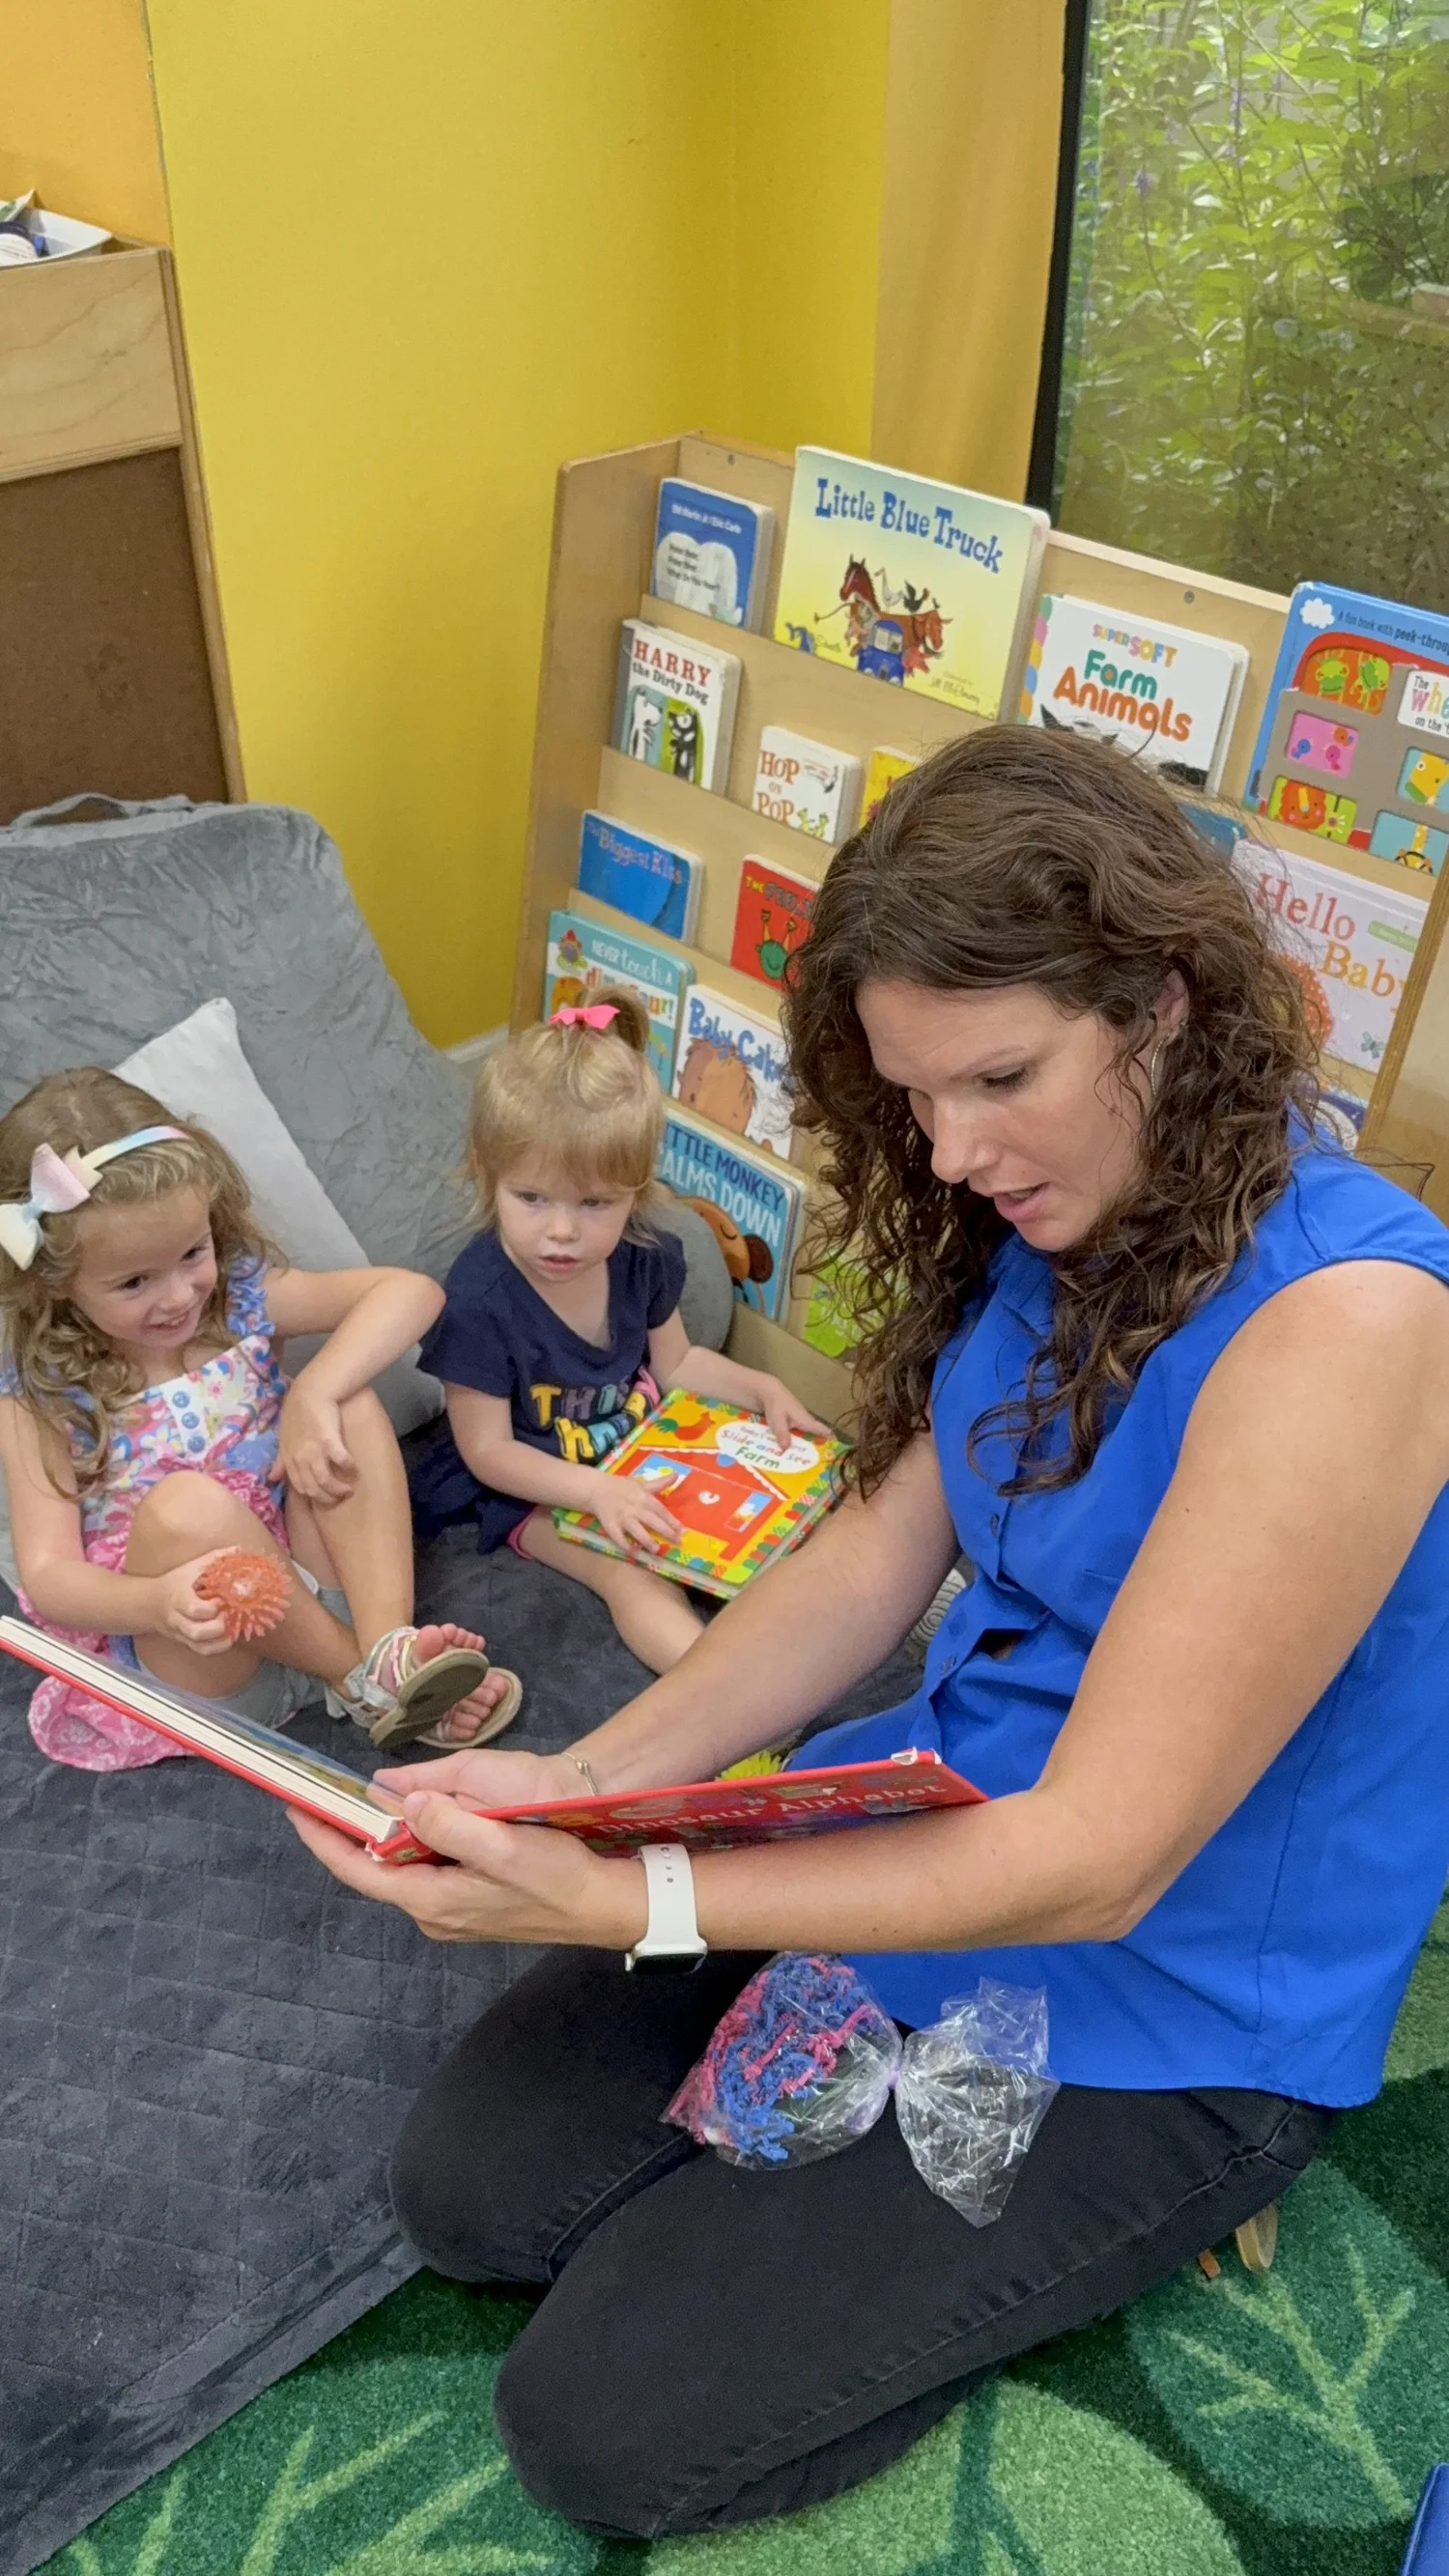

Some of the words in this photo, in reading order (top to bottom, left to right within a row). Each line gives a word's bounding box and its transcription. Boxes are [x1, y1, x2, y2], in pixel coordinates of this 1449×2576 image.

[815, 477, 875, 523] Little
[880, 491, 930, 538] Blue
[933, 505, 1004, 575] Truck
[1093, 624, 1130, 646] SUPER
[1128, 636, 1179, 668] SOFT
[1357, 616, 1376, 631] book
[633, 662, 650, 678] the
[652, 668, 682, 694] Dirty
[684, 682, 709, 706] Dog
[635, 638, 711, 688] HARRY
[1084, 648, 1157, 700] Farm
[1413, 675, 1429, 690] The
[1053, 665, 1193, 743] Animals
[1414, 717, 1425, 727] on
[1428, 718, 1441, 732] the
[759, 750, 800, 785] HOP
[756, 791, 795, 827] POP
[1253, 872, 1356, 942] Hello
[591, 939, 620, 964] NEVER
[621, 948, 661, 983] touch
[1319, 939, 1406, 1001] Bab
[689, 997, 732, 1061] Baby
[715, 1149, 785, 1212] MONKEY
[719, 1180, 782, 1248] DOWN
[721, 1429, 755, 1446] Slide
[735, 1446, 781, 1469] Farm
[594, 1807, 764, 1834] Dinosaur
[779, 1784, 949, 1813] Alphabet
